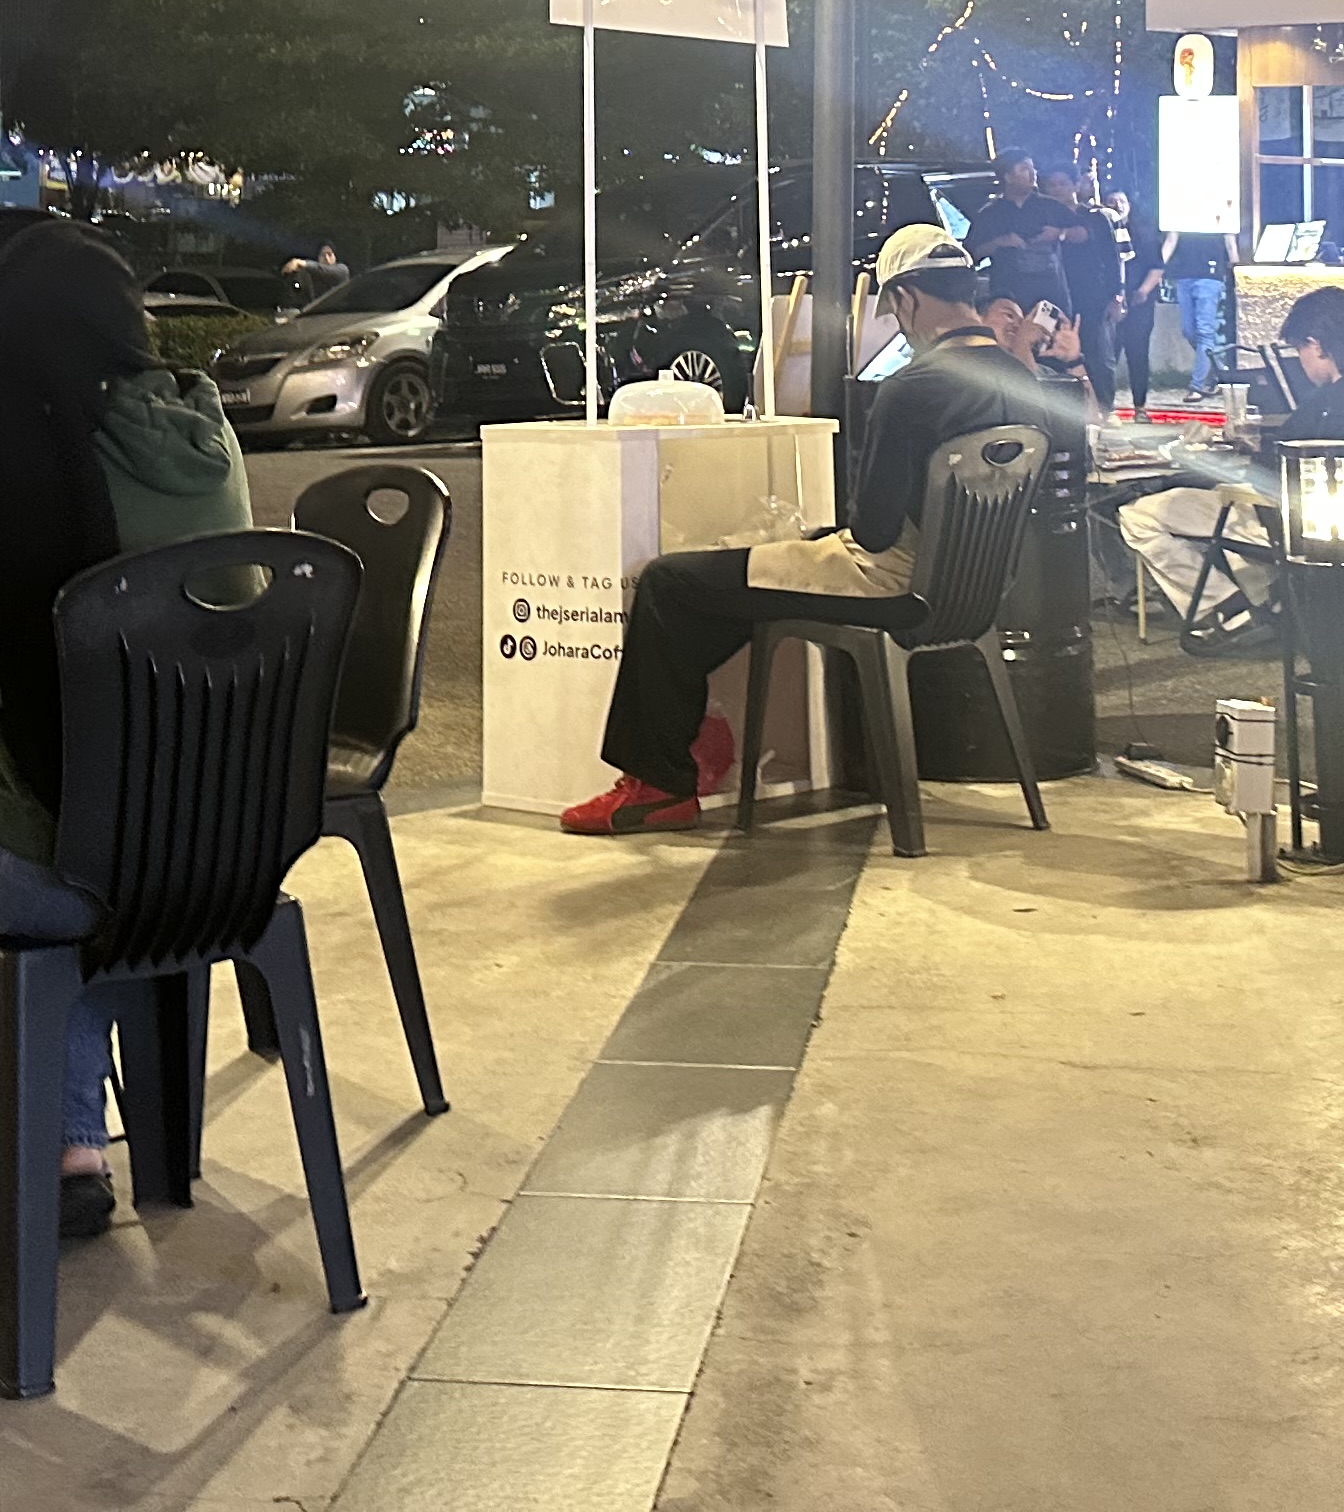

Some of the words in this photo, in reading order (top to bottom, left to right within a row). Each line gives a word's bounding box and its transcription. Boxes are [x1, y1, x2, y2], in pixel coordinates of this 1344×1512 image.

[502, 571, 560, 588] FOLLOW
[566, 574, 575, 588] &
[582, 576, 613, 590] TAG
